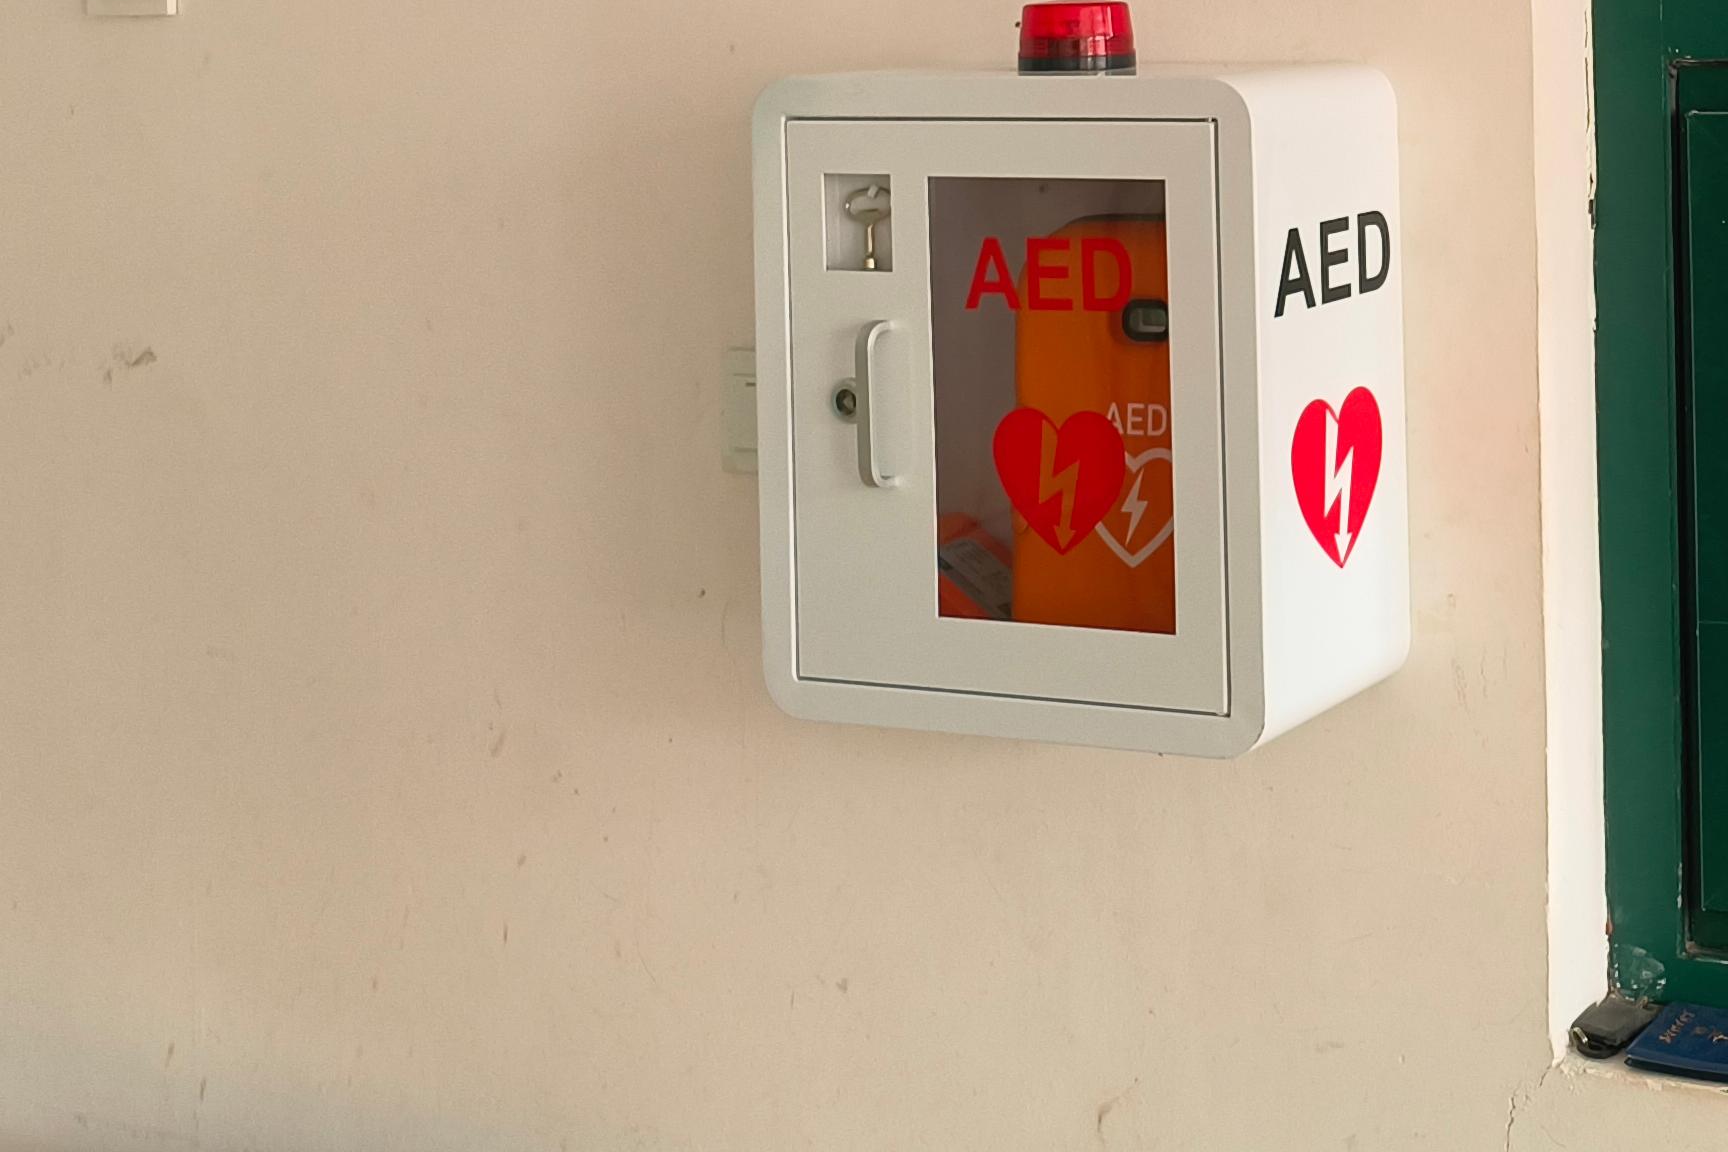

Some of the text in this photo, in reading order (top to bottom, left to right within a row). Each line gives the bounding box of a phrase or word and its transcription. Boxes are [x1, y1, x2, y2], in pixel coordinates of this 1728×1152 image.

[965, 237, 1133, 311] AED
[1274, 210, 1391, 318] AED
[1106, 401, 1168, 437] AED
